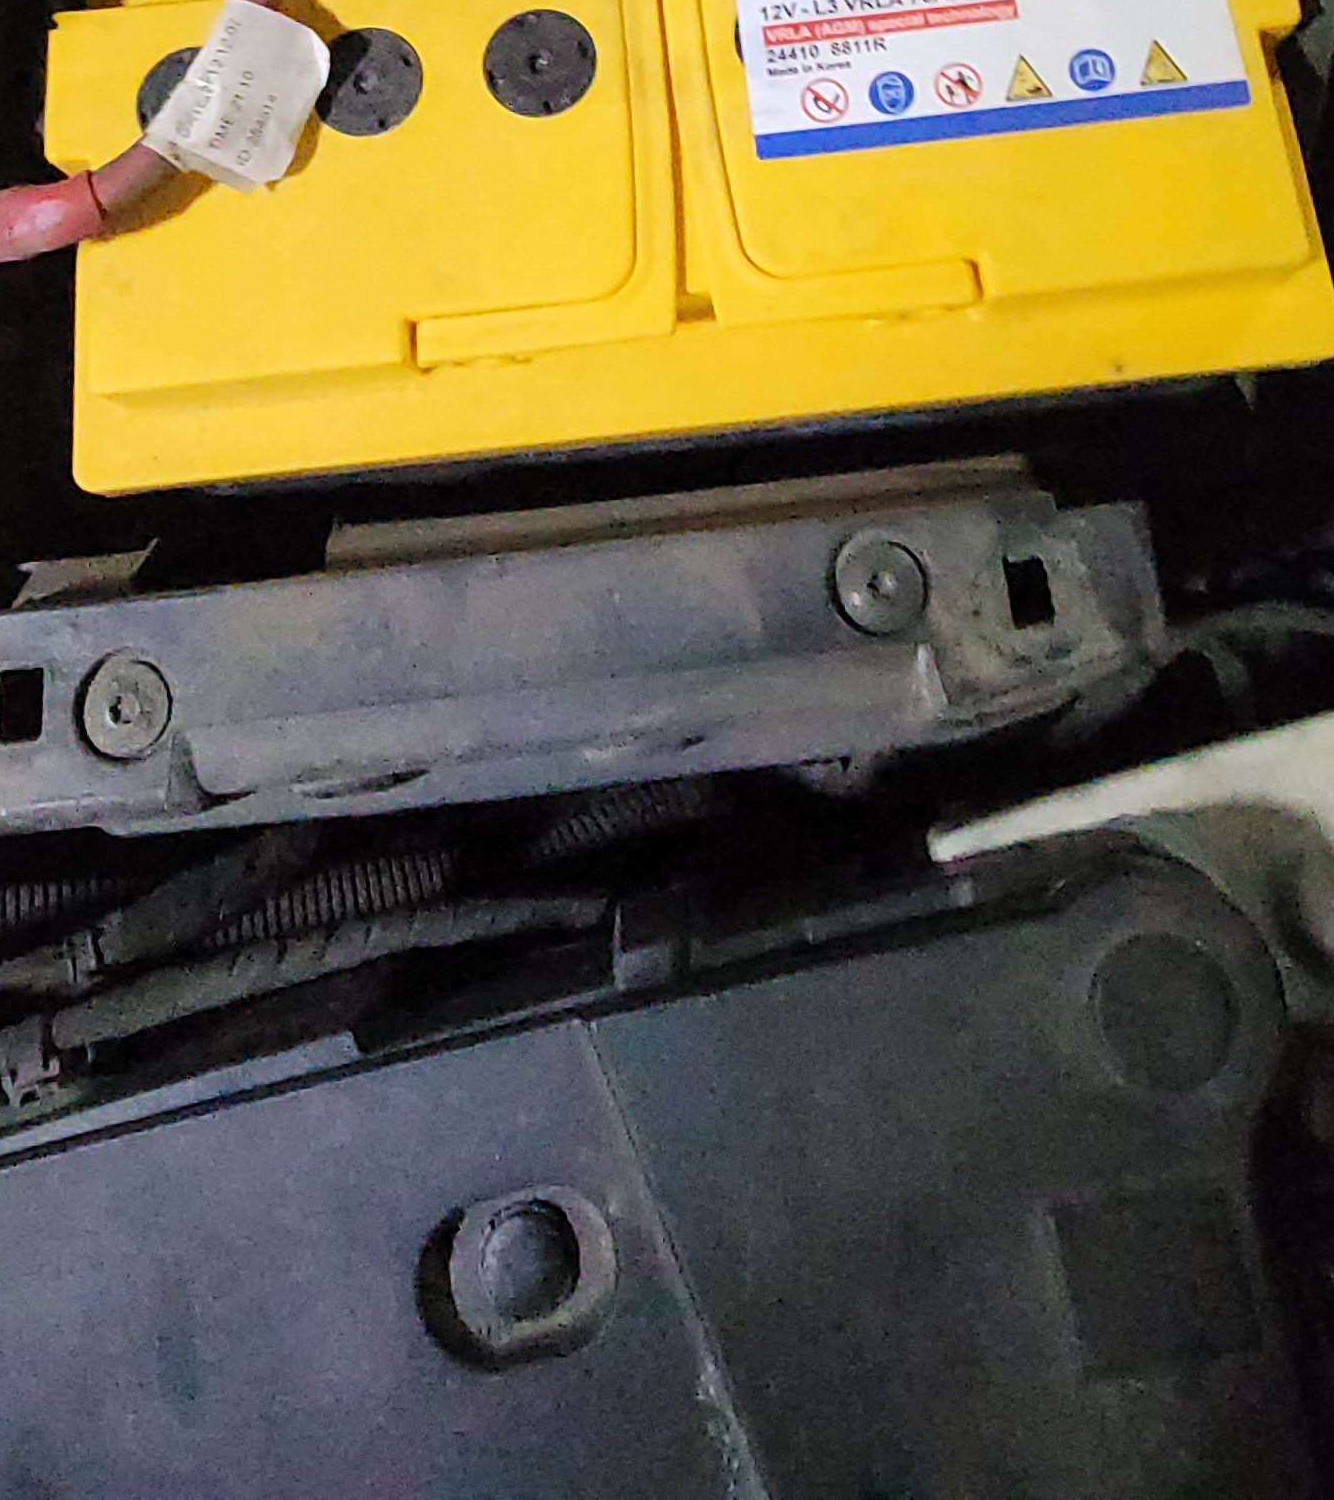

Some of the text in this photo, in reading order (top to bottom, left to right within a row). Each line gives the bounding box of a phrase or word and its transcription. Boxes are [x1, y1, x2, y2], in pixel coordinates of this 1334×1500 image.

[761, 2, 797, 21] 12V
[812, 0, 838, 16] L3
[767, 26, 812, 43] VRLA
[767, 37, 888, 63] 24410 8811R
[767, 66, 799, 77] Made
